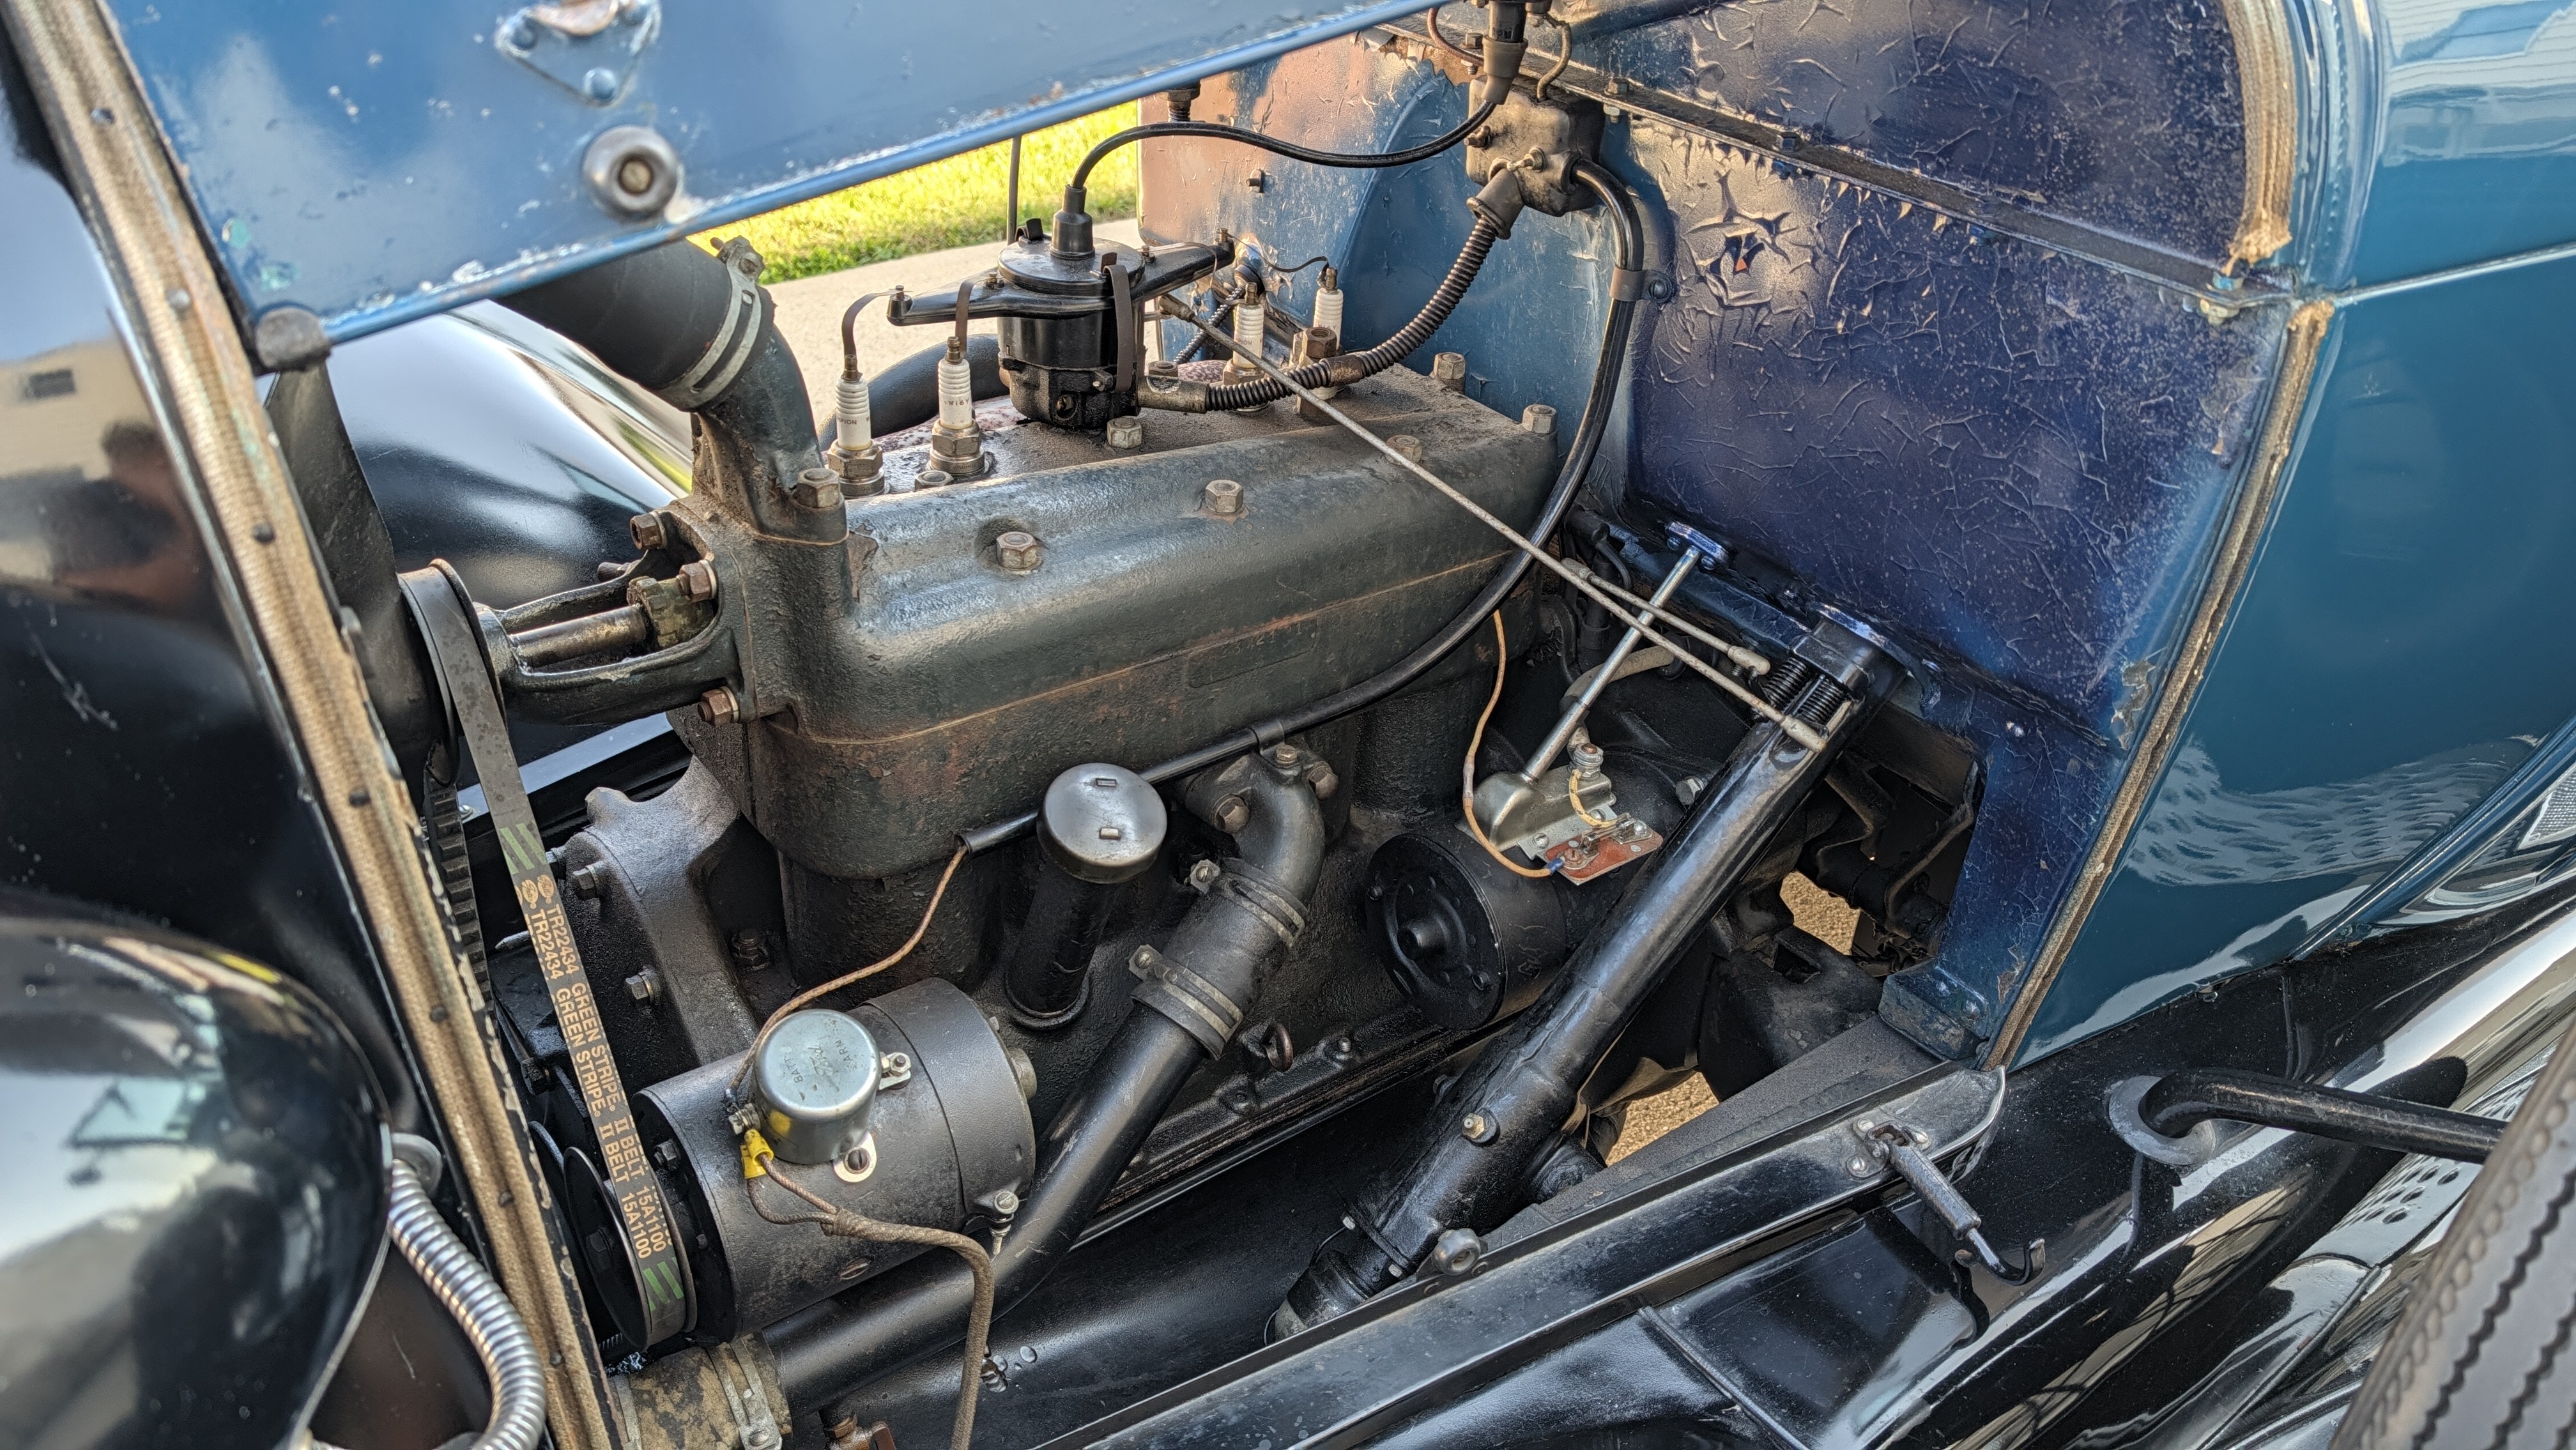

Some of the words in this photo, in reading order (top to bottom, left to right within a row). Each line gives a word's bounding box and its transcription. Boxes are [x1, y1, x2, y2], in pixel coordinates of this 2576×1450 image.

[531, 908, 564, 980] TR22434
[547, 903, 579, 974] TR22434
[556, 988, 586, 1048] GREEN
[572, 982, 602, 1042] GREEN
[783, 1055, 804, 1083] BATT
[834, 1040, 853, 1062] ARM
[599, 1122, 615, 1140] II
[614, 1117, 630, 1134] II
[605, 1141, 630, 1182] BELT
[620, 1135, 645, 1177] BELT
[621, 1192, 652, 1259] 15A1100
[636, 1186, 667, 1252] 15A1100
